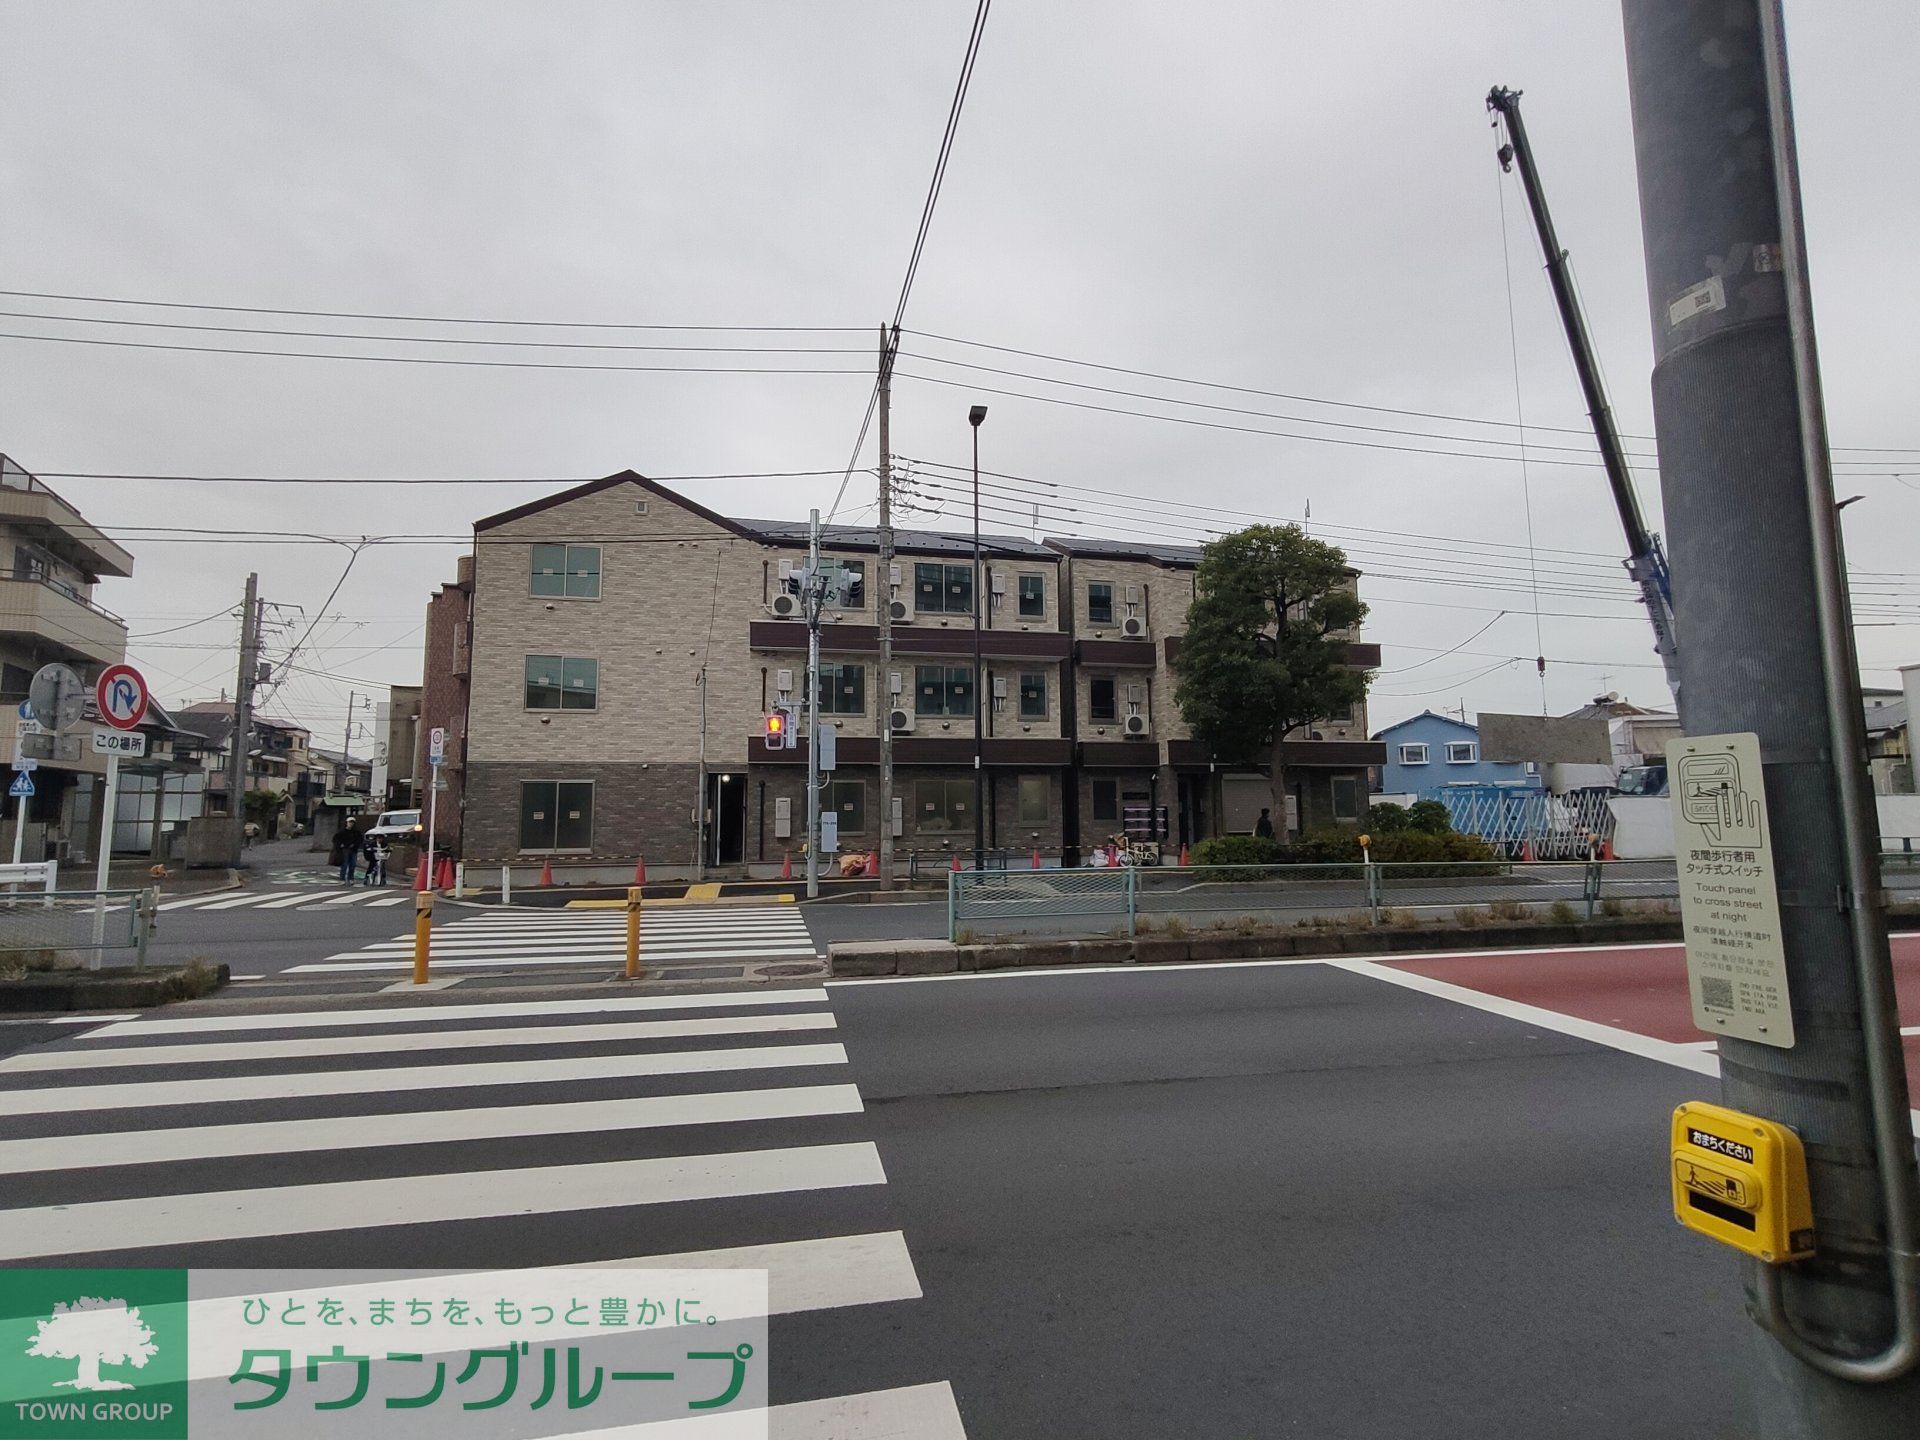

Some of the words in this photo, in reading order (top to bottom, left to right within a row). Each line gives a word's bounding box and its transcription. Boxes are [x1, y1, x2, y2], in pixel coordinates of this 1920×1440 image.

[96, 734, 142, 752] この場所
[1690, 849, 1756, 863] 夜間歩行者用
[1686, 863, 1763, 878] タッチ式スイッチ
[1696, 882, 1726, 894] Touch
[1728, 885, 1756, 898] panel
[1693, 896, 1702, 905] to
[1704, 898, 1731, 907] cross
[1733, 899, 1763, 910] street
[1710, 911, 1720, 920] at
[1722, 912, 1748, 923] night
[1692, 1131, 1753, 1161] おまちください
